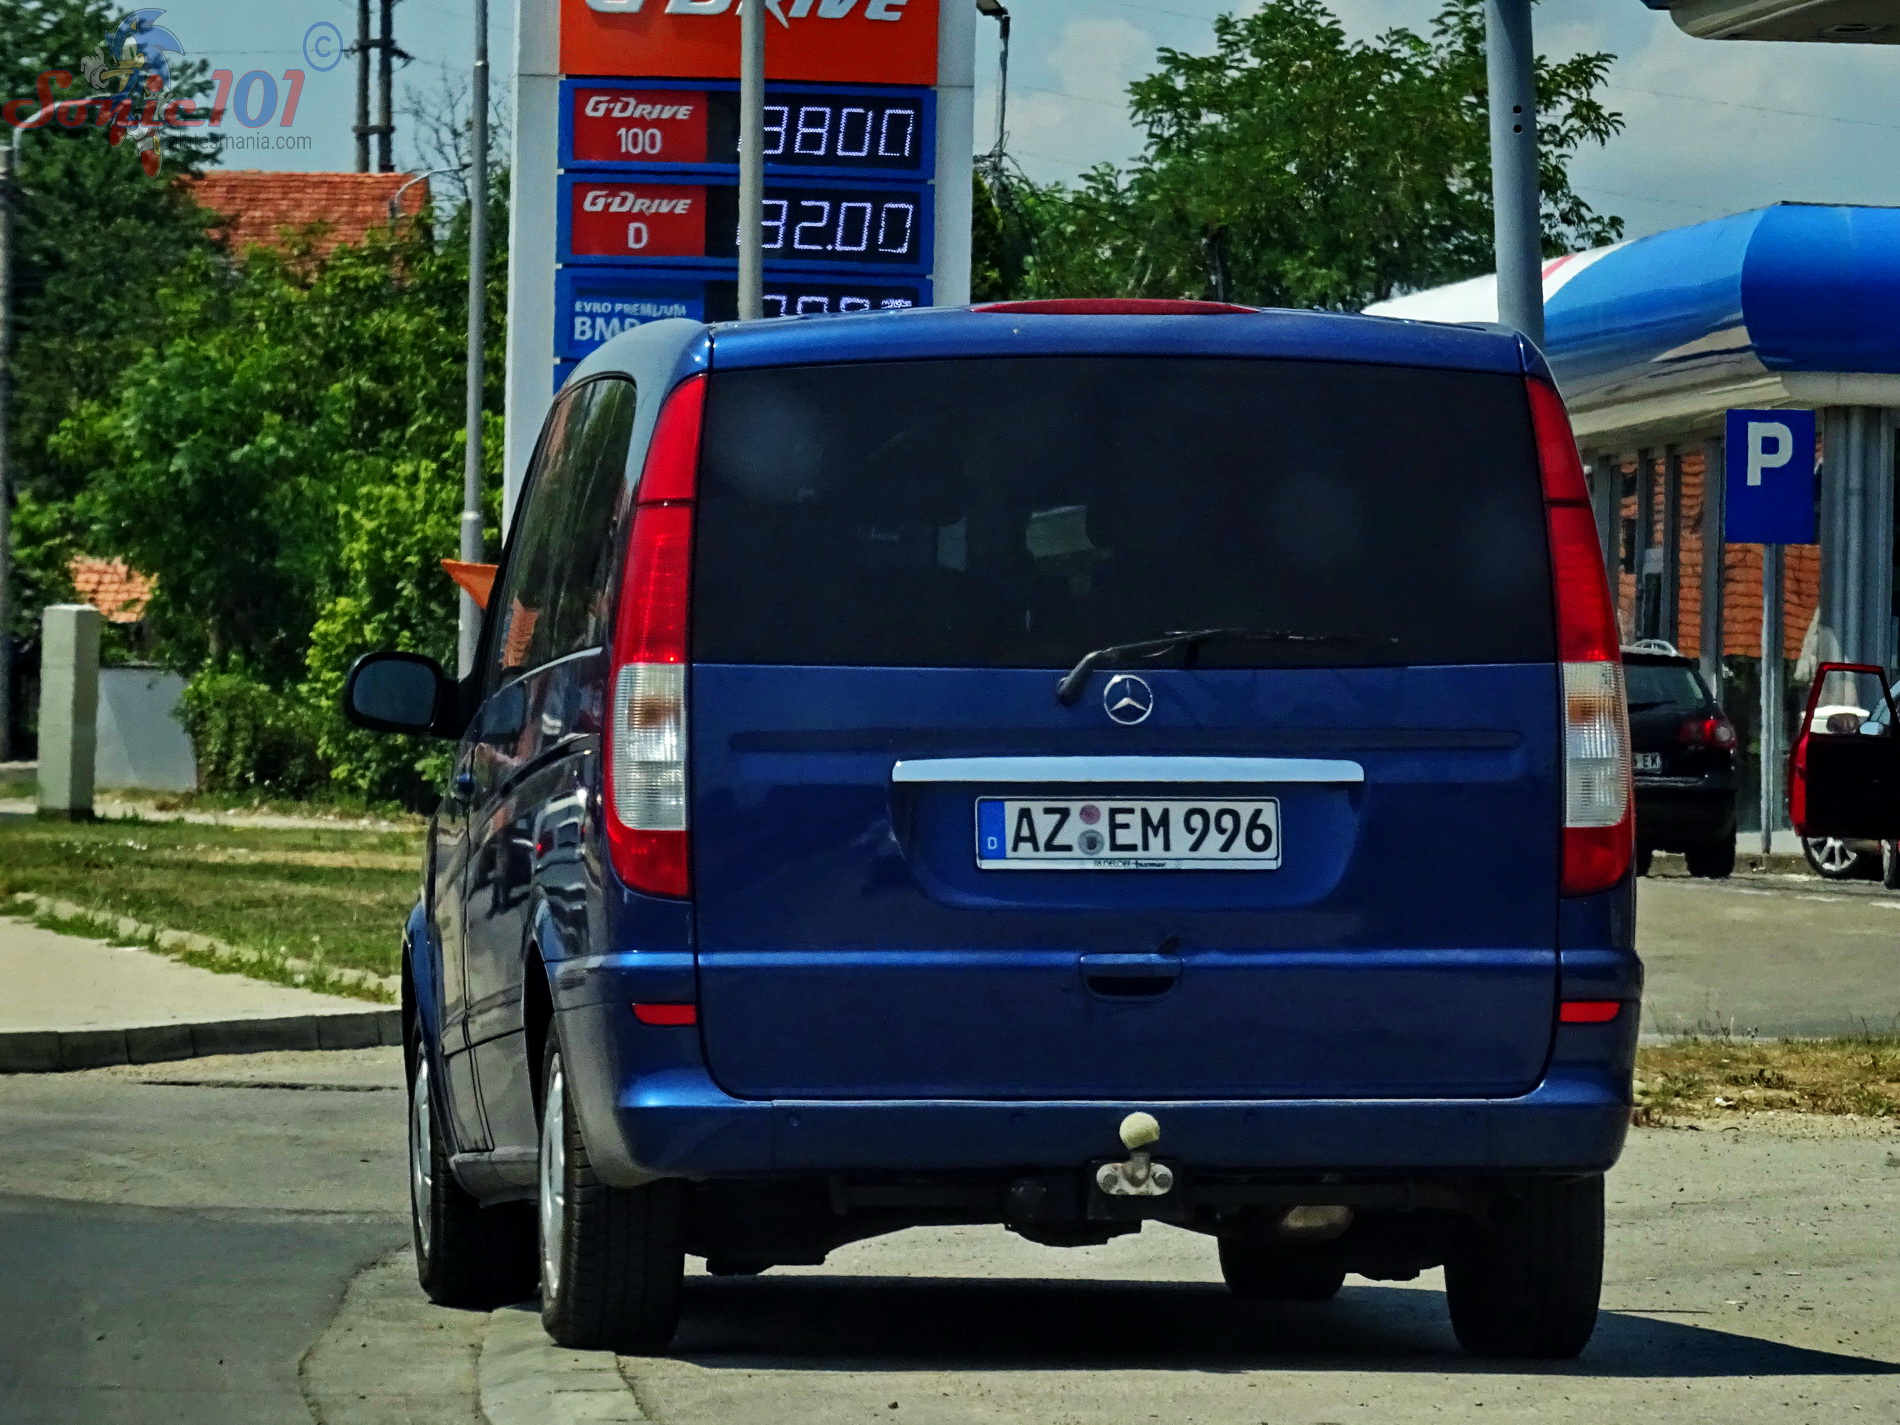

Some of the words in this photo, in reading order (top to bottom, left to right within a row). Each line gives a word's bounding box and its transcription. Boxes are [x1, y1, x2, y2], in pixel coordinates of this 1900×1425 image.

[616, 127, 662, 154] 100
[737, 106, 914, 157] 3800
[627, 222, 648, 249] D
[736, 200, 913, 253] 32.00
[575, 301, 612, 313] EVRO
[614, 303, 686, 317] PREMIUM
[1746, 421, 1793, 486] P
[987, 836, 998, 849] D
[1011, 807, 1074, 852] AZ
[1108, 807, 1170, 852] EM
[1183, 807, 1272, 852] 996
